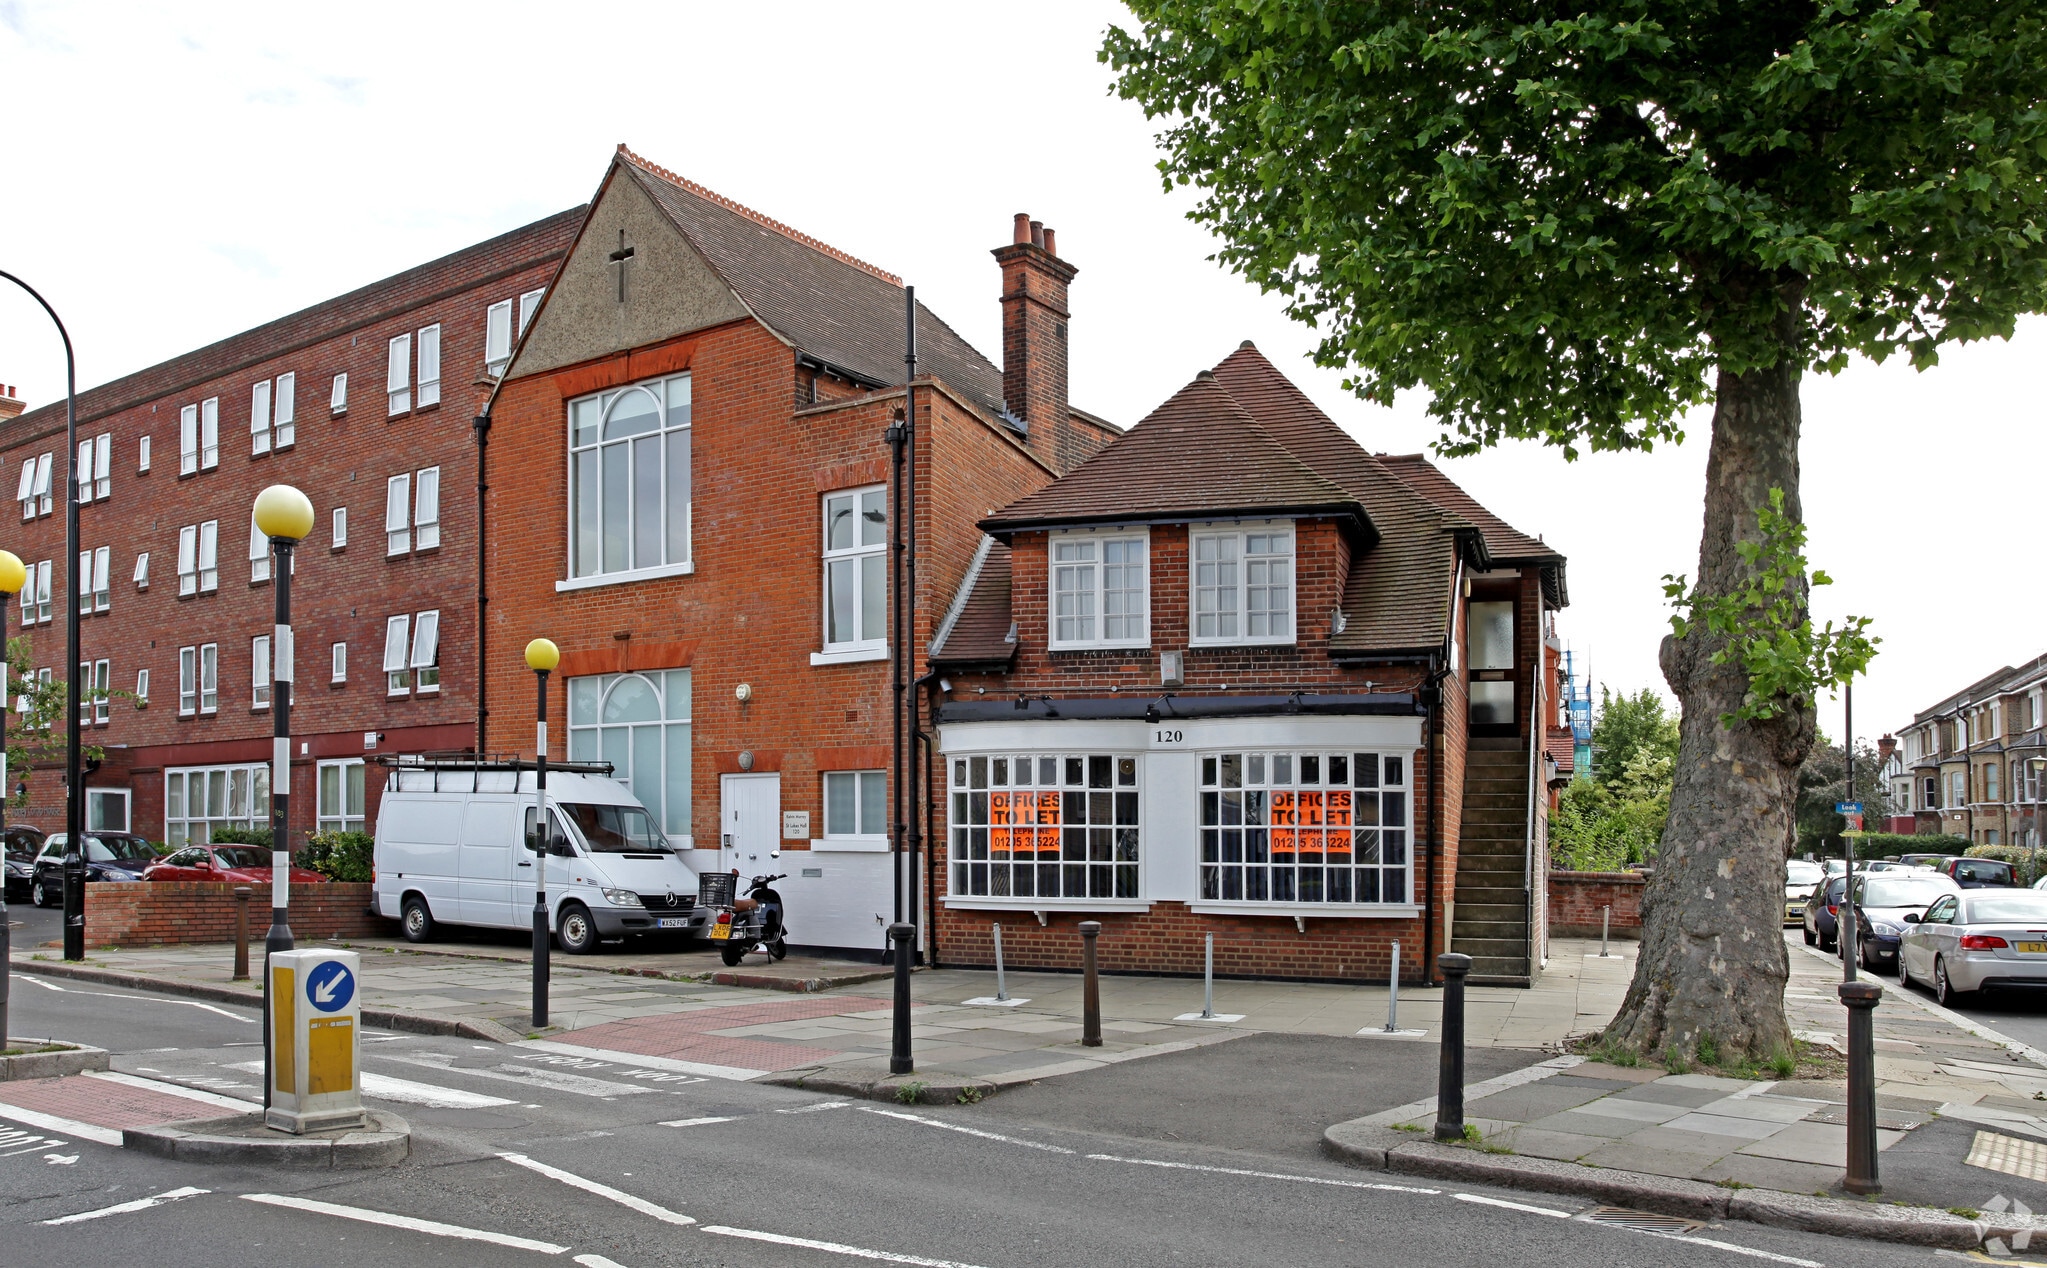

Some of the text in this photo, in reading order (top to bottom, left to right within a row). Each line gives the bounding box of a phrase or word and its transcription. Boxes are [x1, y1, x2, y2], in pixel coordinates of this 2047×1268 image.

[1155, 730, 1183, 743] 120
[993, 794, 1060, 808] OFFICES
[1272, 793, 1351, 807] OFFICES
[994, 810, 1060, 825] TO LET
[1273, 810, 1351, 825] TO LET
[513, 1053, 710, 1085] LOOK RIGHT
